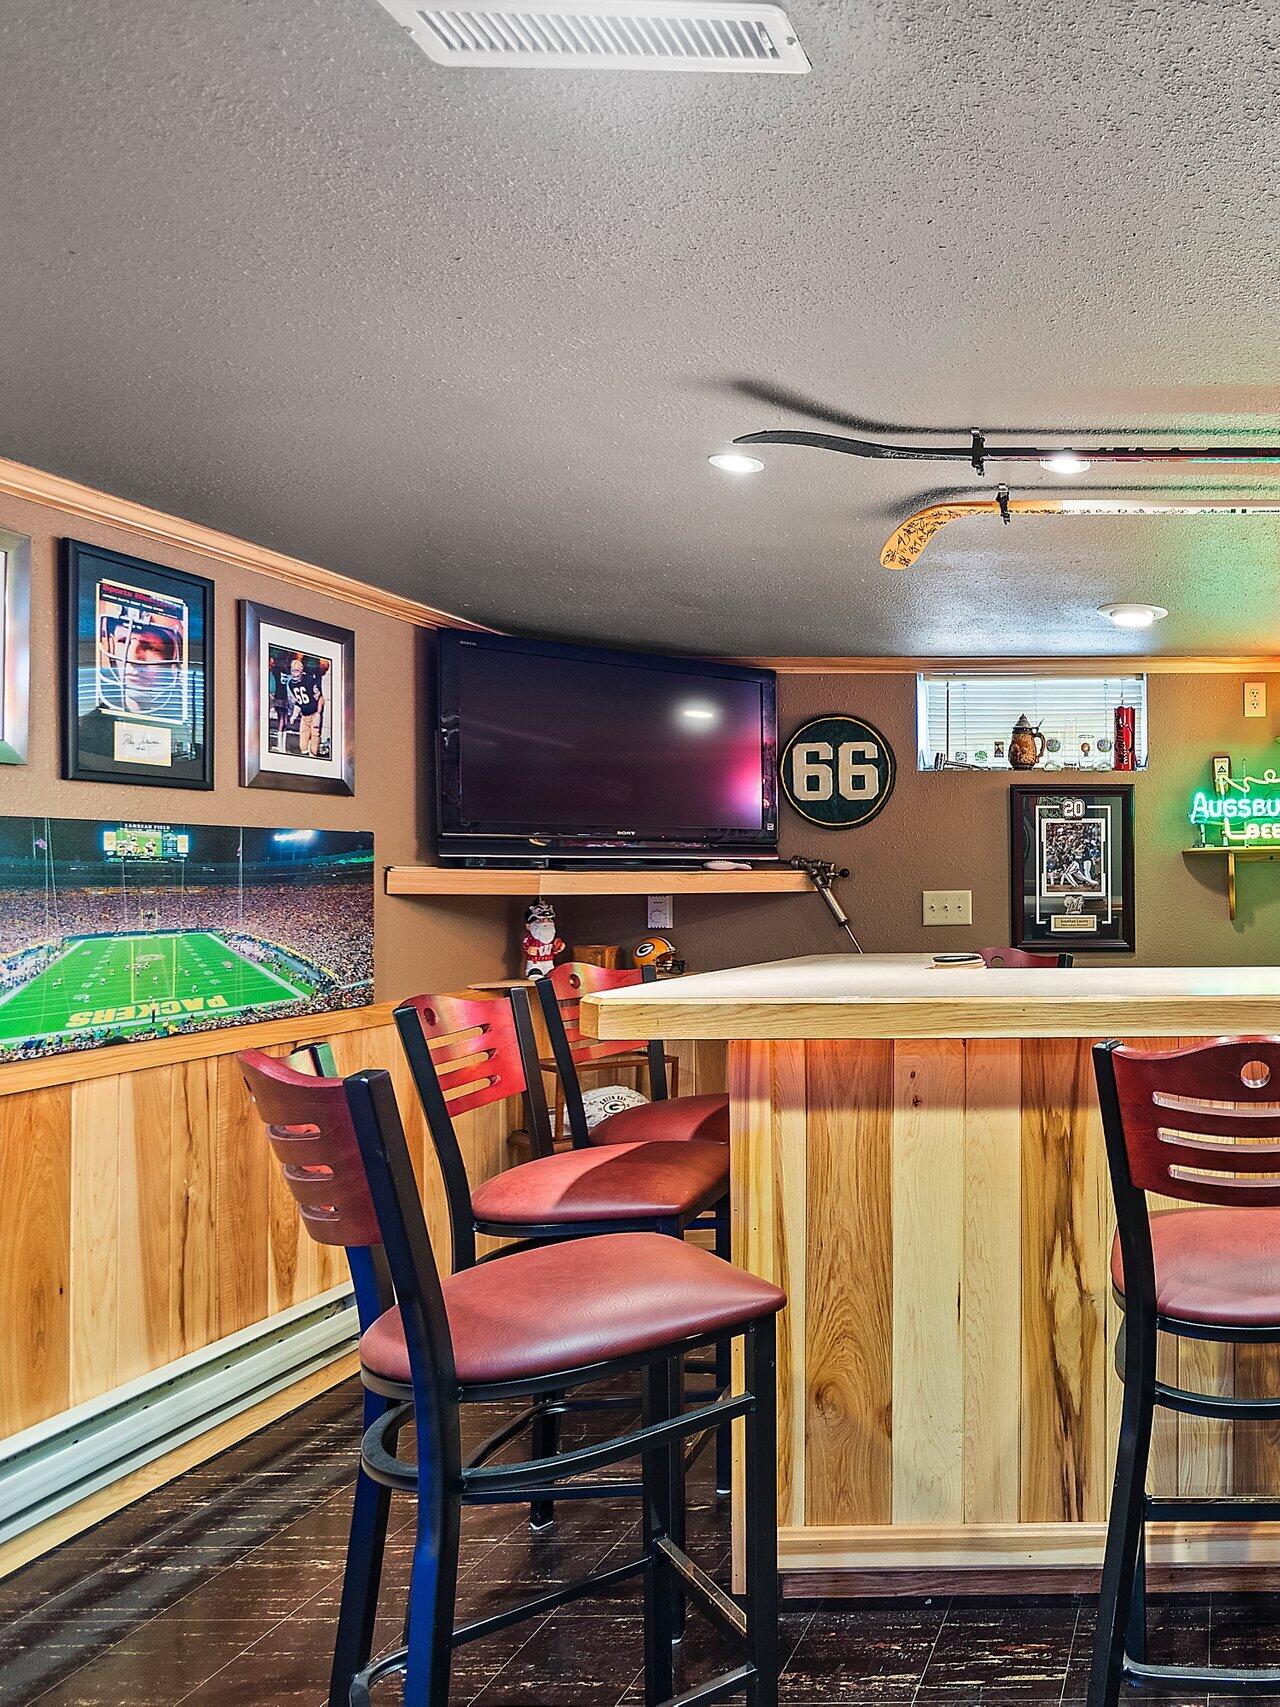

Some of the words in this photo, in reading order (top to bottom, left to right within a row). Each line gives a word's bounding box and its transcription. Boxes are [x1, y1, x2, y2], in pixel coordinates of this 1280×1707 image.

[792, 741, 879, 801] 66
[1063, 800, 1085, 818] 20
[65, 994, 229, 1028] PACKERS
